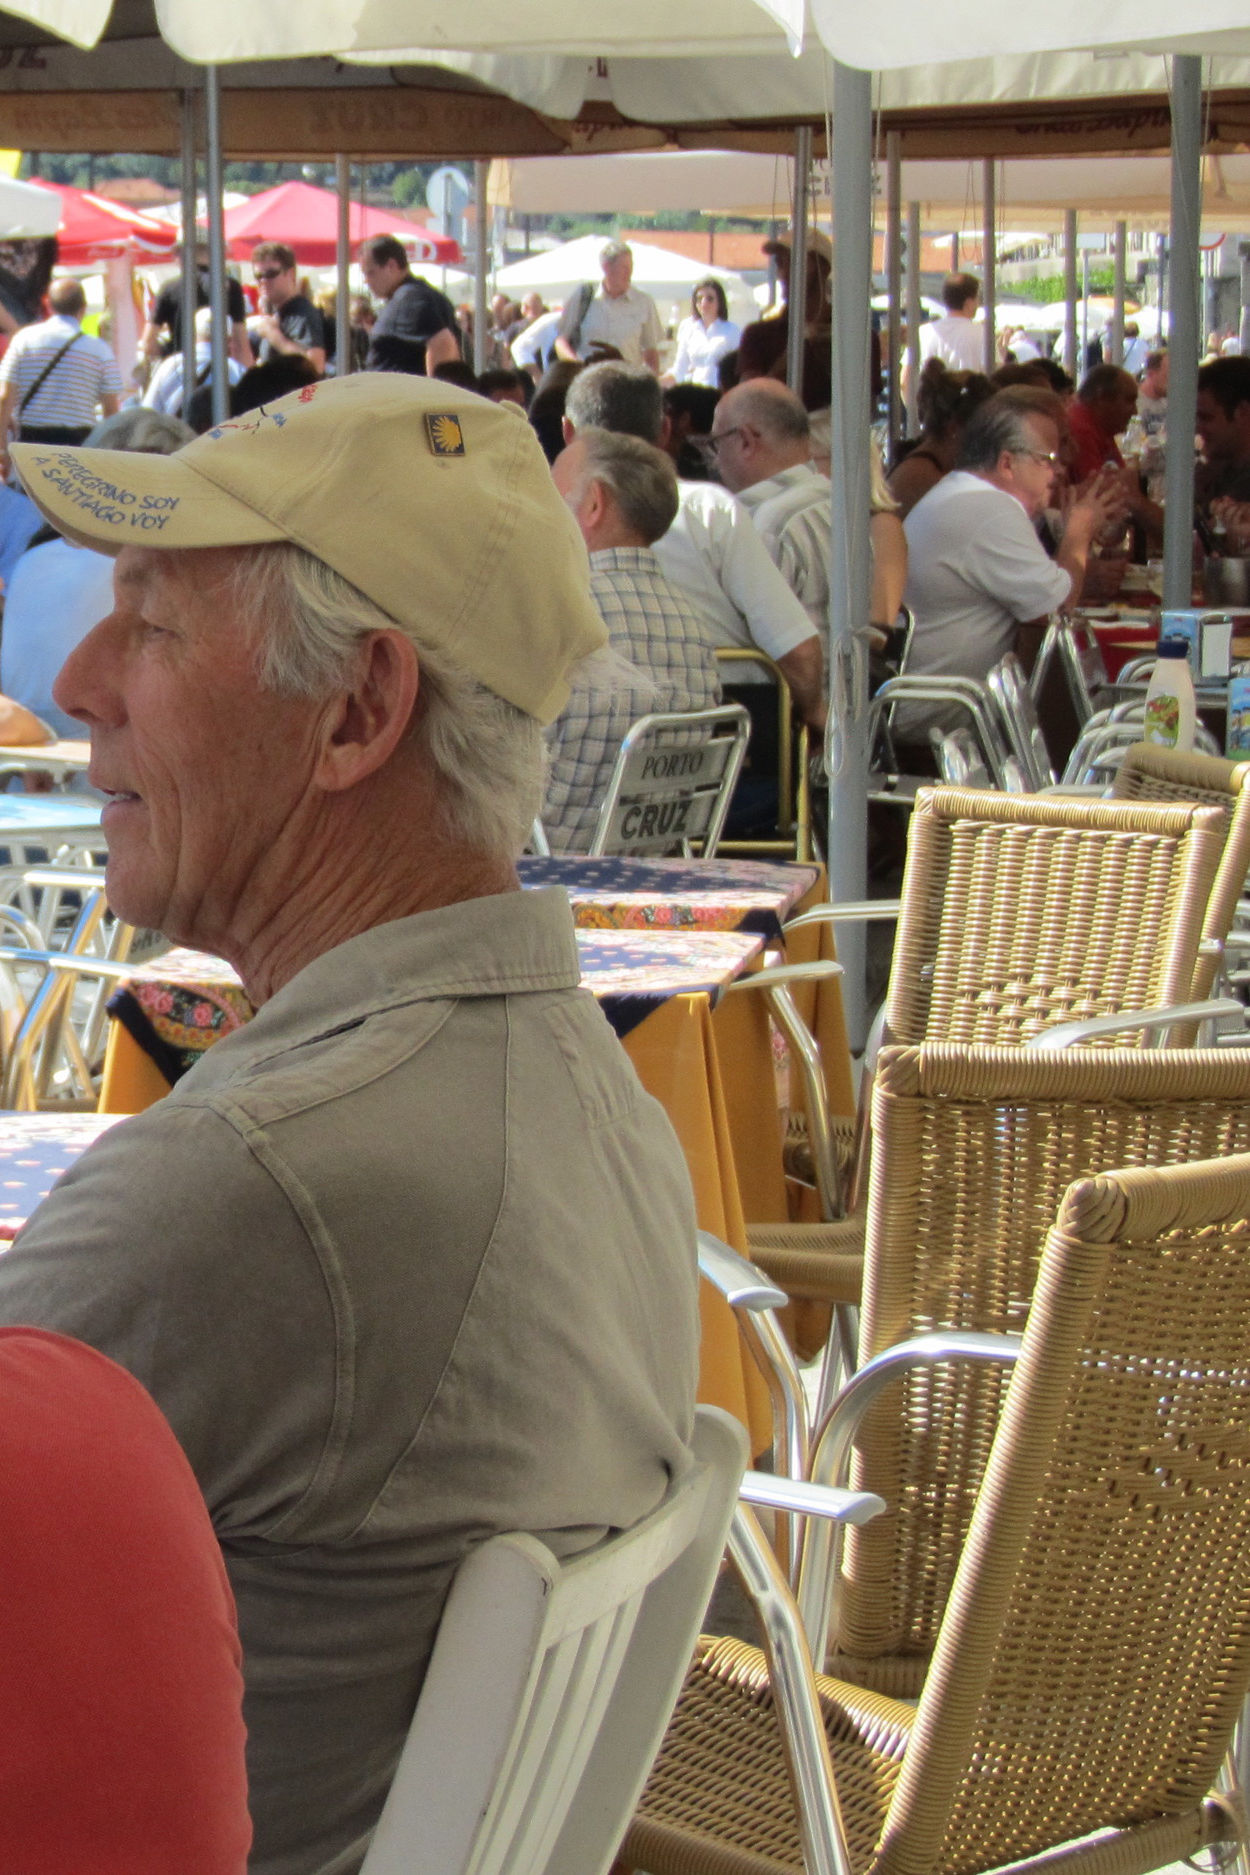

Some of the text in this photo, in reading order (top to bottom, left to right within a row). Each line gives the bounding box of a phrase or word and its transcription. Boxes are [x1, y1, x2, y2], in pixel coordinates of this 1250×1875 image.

[31, 456, 170, 530] A SANTIAGO VOY
[52, 452, 180, 510] PEREGRINO SOY
[641, 751, 704, 780] PORTO
[620, 800, 692, 839] CRUZ
